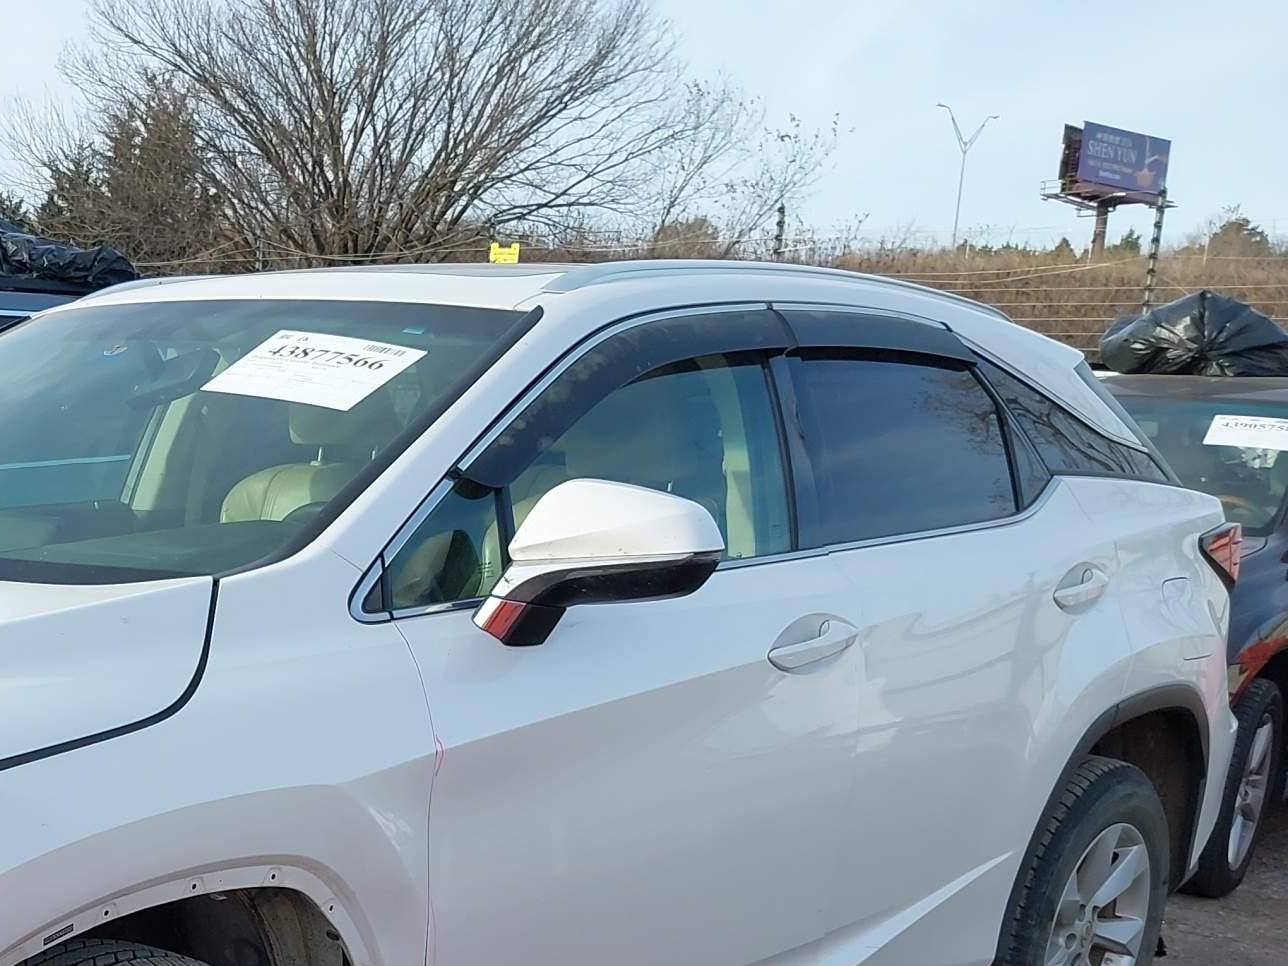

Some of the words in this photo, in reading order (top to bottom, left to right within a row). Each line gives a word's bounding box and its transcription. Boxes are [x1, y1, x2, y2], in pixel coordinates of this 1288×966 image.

[1088, 140, 1114, 159] SHEN
[1115, 147, 1138, 163] YUN
[269, 344, 387, 370] 43877566
